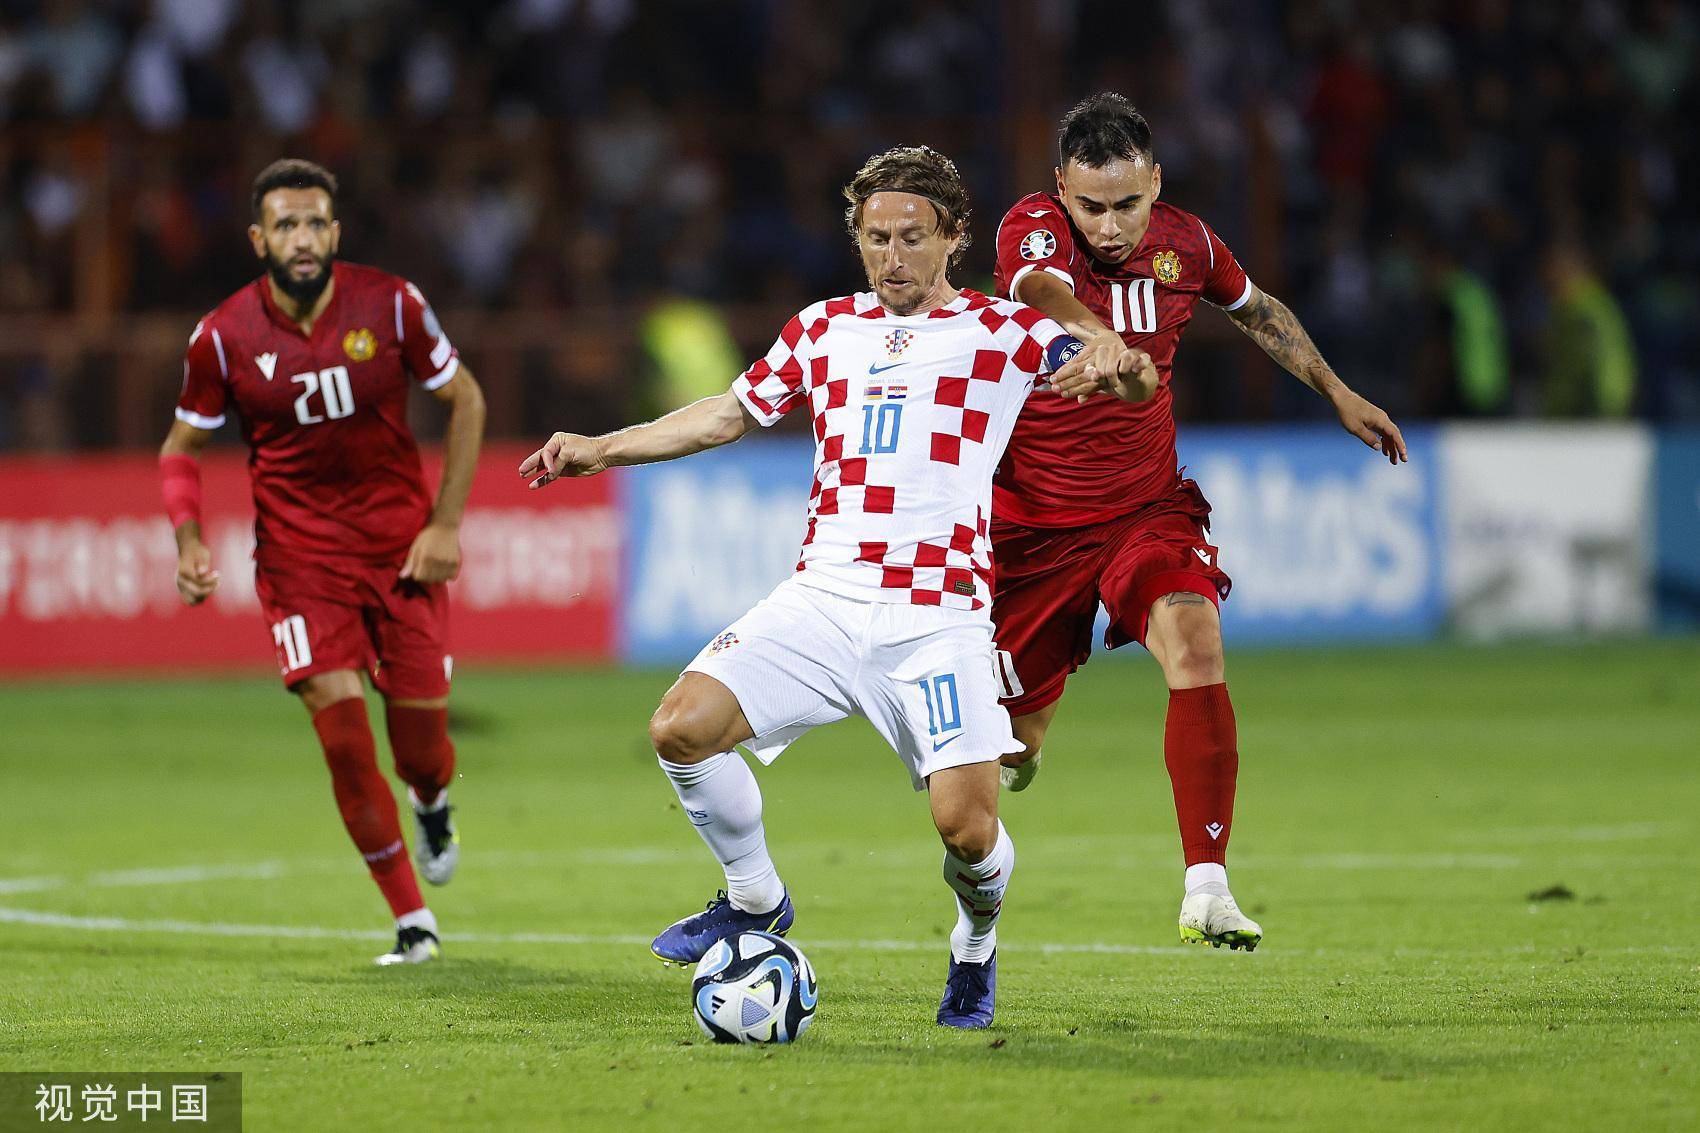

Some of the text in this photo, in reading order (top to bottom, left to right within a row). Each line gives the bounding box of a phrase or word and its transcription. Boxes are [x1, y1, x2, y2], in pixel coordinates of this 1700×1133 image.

[1109, 278, 1157, 333] 10
[291, 365, 356, 426] 20
[858, 403, 903, 455] 10
[919, 672, 962, 736] 10
